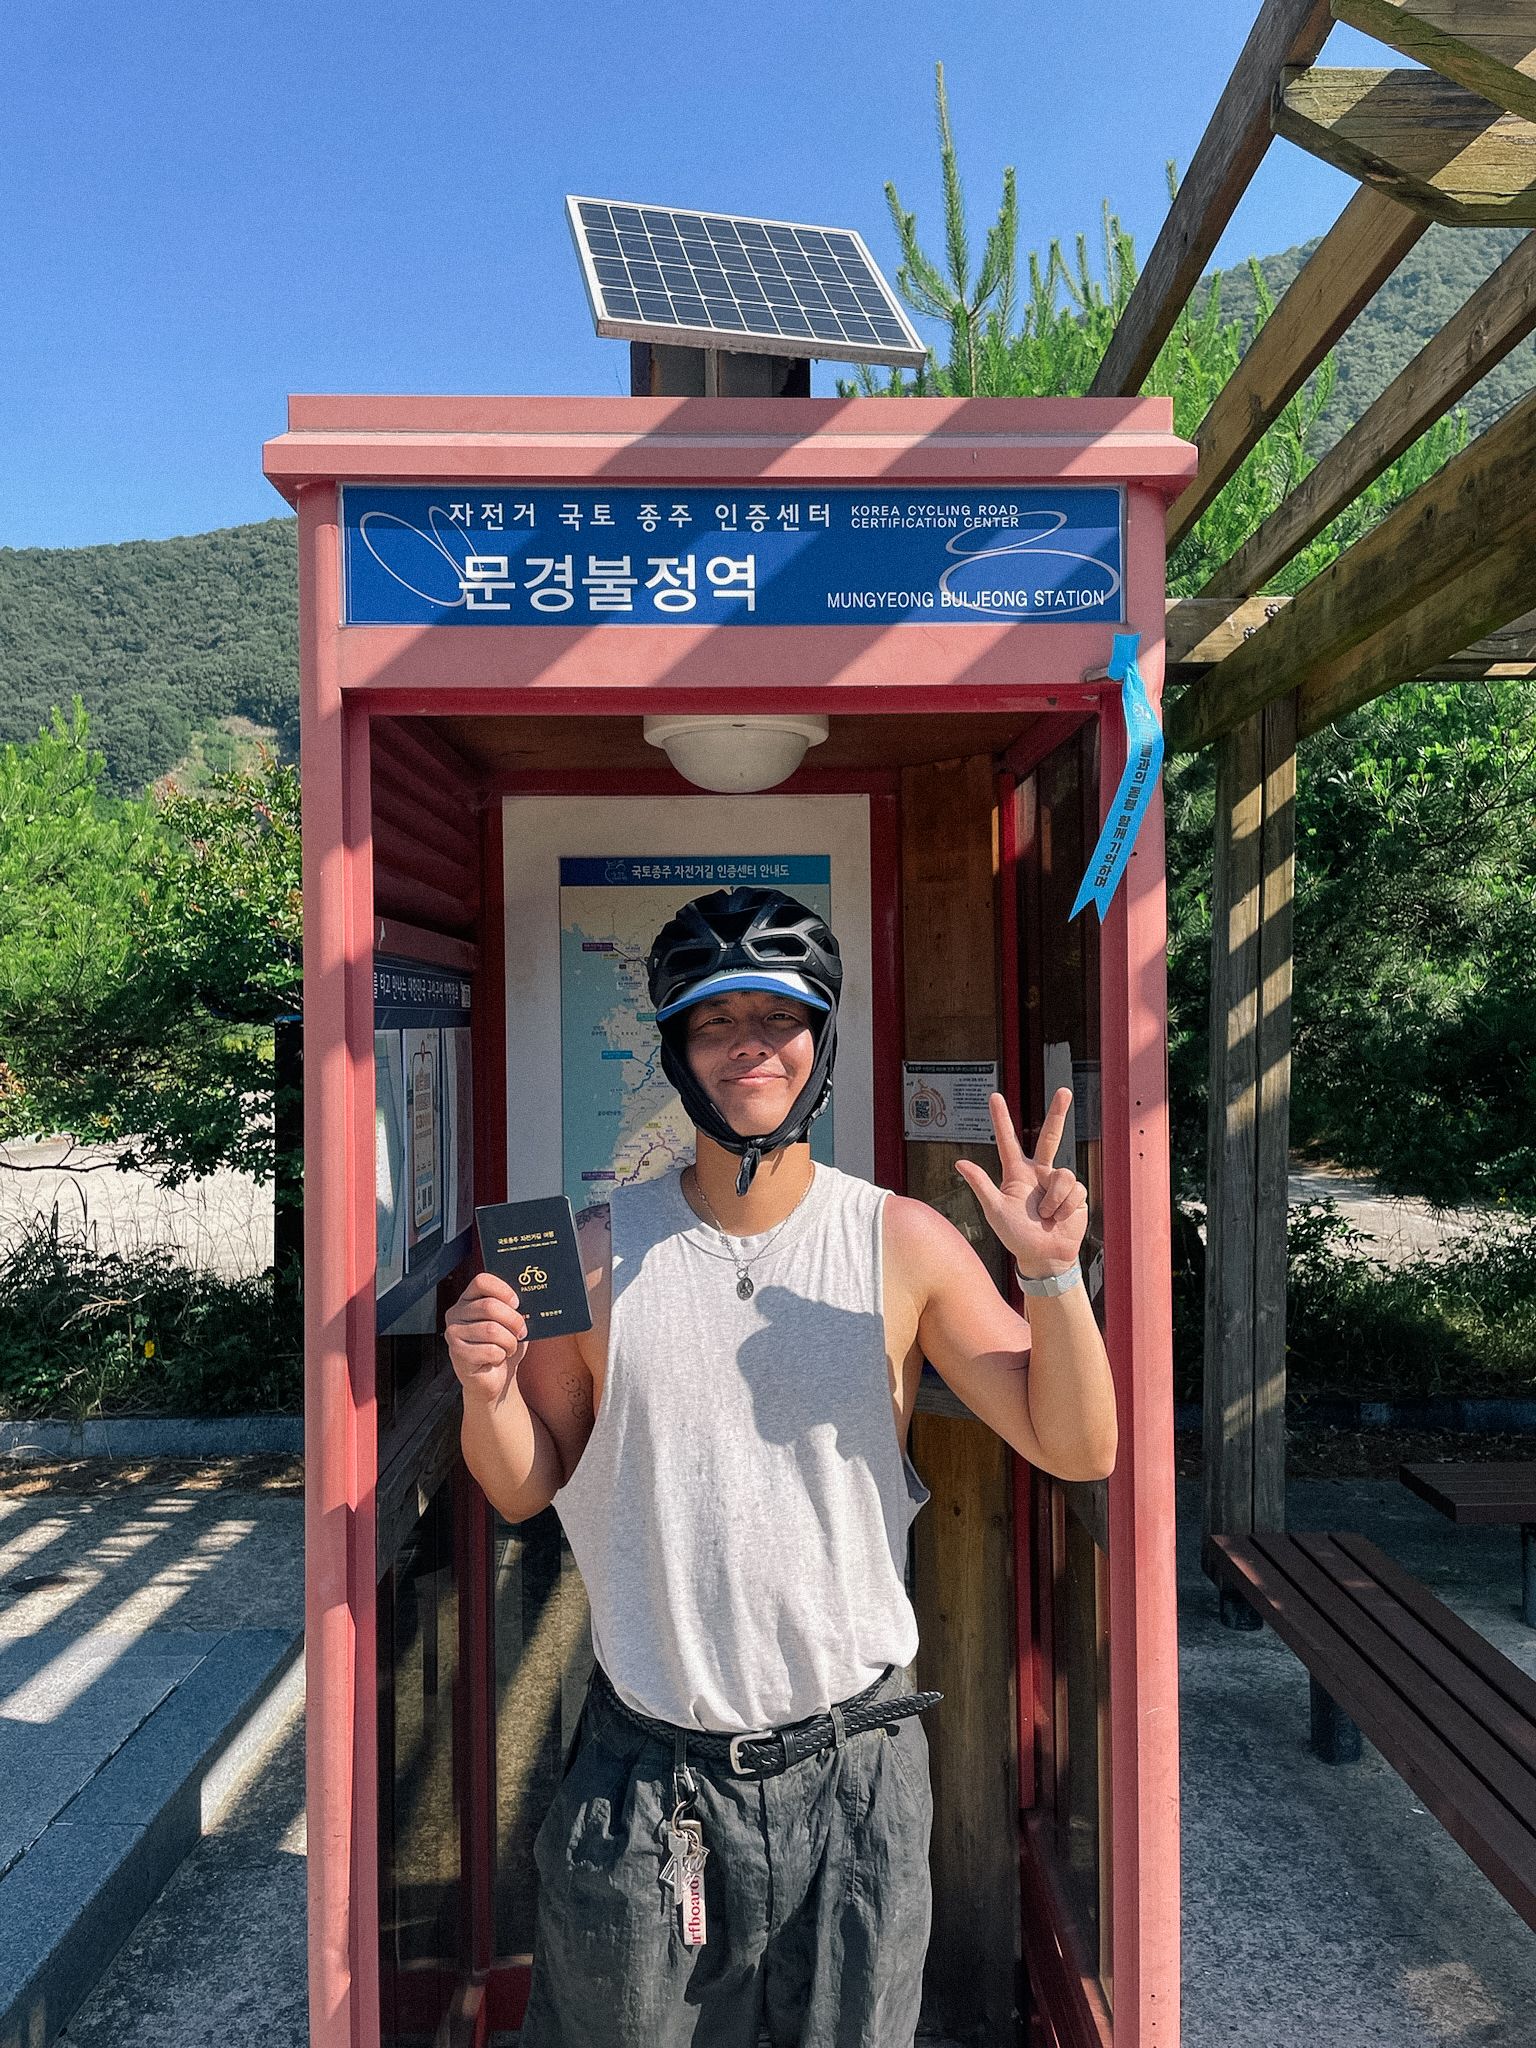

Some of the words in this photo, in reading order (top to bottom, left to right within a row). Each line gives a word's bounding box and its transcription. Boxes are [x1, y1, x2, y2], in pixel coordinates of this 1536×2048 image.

[449, 502, 536, 531] 자전거
[558, 503, 616, 531] 국토
[636, 503, 693, 532] 종주
[715, 503, 831, 532] 인증센터
[851, 505, 901, 516] KOREA
[907, 505, 970, 516] CYCLING
[978, 505, 1019, 516] ROAD
[851, 517, 957, 528] CERTIFICATION
[963, 517, 1019, 528] CENTER
[458, 554, 756, 612] 문경불정역
[827, 592, 934, 609] MUNGYEONG
[940, 591, 1028, 608] BULJEONG
[1034, 590, 1105, 607] STATION
[1113, 815, 1131, 841] 함께
[631, 864, 672, 880] 국토종주
[674, 864, 714, 879] 자전거길
[716, 864, 757, 879] 인증센터
[760, 864, 790, 878] 안내도
[1094, 841, 1121, 889] 기억하며
[521, 1283, 548, 1293] PASSPORT
